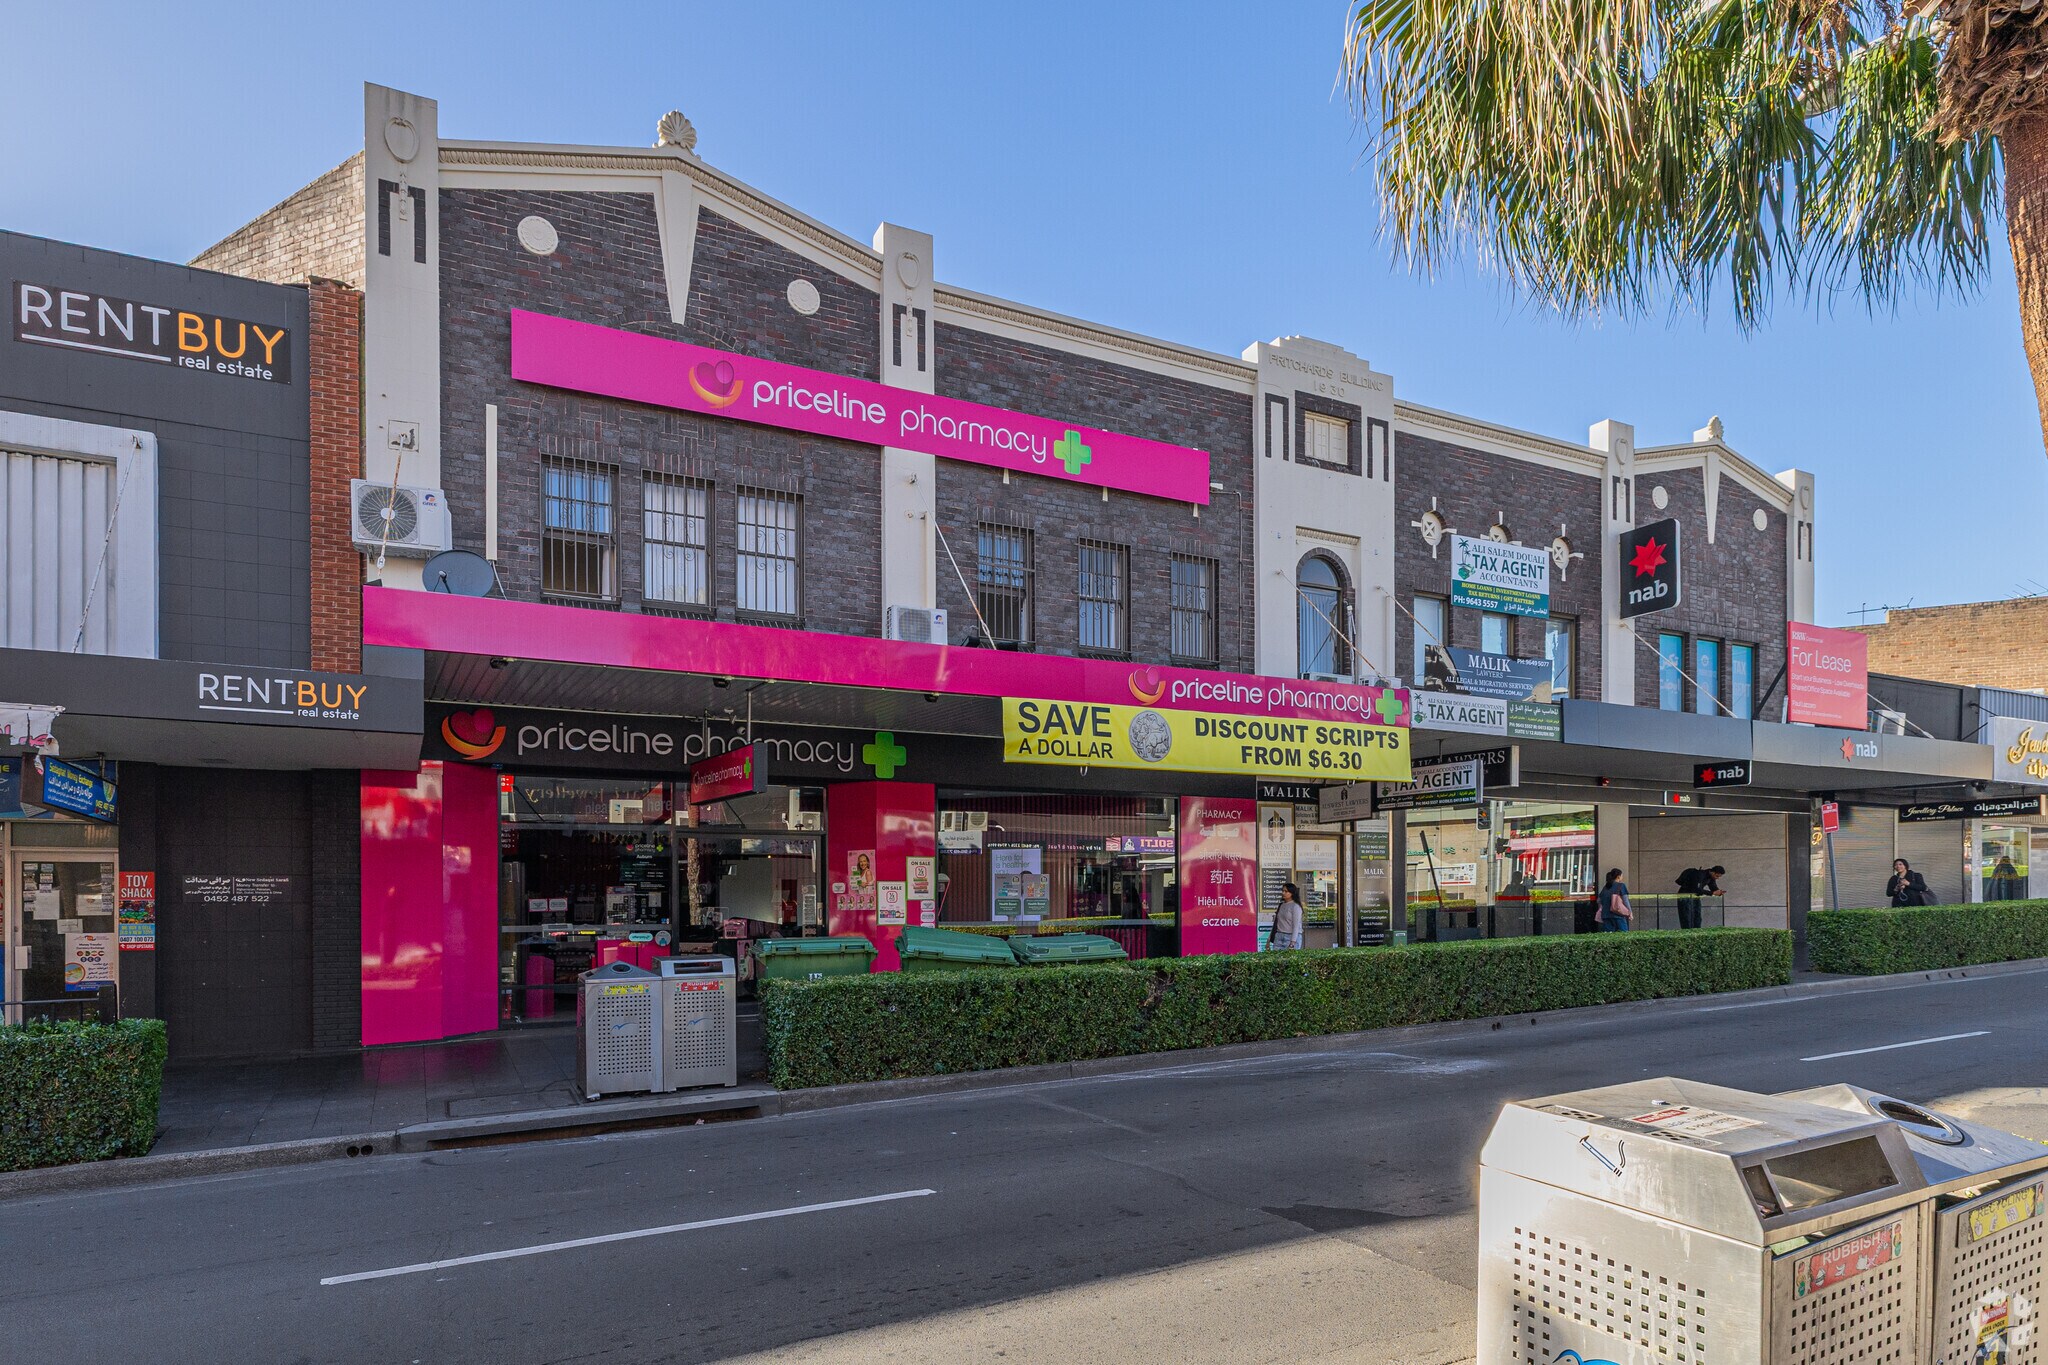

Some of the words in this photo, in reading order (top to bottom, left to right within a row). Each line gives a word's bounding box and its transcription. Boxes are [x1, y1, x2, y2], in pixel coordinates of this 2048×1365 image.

[22, 284, 284, 365] RENTBUY
[179, 355, 210, 371] real
[217, 360, 273, 381] estate
[1339, 371, 1384, 391] BUILDING
[753, 380, 886, 424] priceline
[900, 405, 1047, 464] pharmacy
[1471, 544, 1487, 554] ALI
[1487, 546, 1514, 559] SALEM
[1516, 551, 1545, 564] DOUALI
[1472, 554, 1498, 572] TAX
[1501, 559, 1545, 579] AGENT
[1480, 572, 1539, 588] ACCOUNTANTS
[1462, 582, 1476, 590] HOME
[1496, 588, 1525, 597] INVESTMENT
[1478, 592, 1500, 600] RETURNS
[1628, 579, 1668, 605] nab
[1453, 594, 1465, 604] PH:
[1465, 597, 1482, 607] 9643
[1482, 599, 1498, 608] 5557
[1468, 654, 1511, 672] MALIK
[1791, 646, 1813, 667] For
[1815, 649, 1852, 673] Lease
[1476, 669, 1503, 679] LAWYERS
[199, 673, 367, 710] RENTBUY
[1456, 685, 1523, 696] WWW.MALIKLAWYERS.COM.AU
[1457, 677, 1474, 685] LEGAL
[1479, 679, 1508, 688] MIGRATION
[1508, 682, 1533, 690] SERVICES
[1171, 679, 1263, 706] priceline
[1267, 683, 1372, 720] pharmacy
[1471, 702, 1505, 710] ACCOUNTANTS
[297, 706, 319, 718] real
[322, 707, 359, 721] estate
[1018, 702, 1112, 738] SAVE
[1428, 704, 1455, 720] TAX
[1458, 707, 1505, 725] AGENT
[517, 724, 673, 755] priceline
[1195, 717, 1309, 744] DISCOUNT
[1314, 727, 1400, 750] SCRIPTS
[1018, 738, 1033, 754] A
[1037, 739, 1114, 760] DOLLAR
[1241, 745, 1302, 767] FROM
[1307, 748, 1363, 770] $6.30
[1855, 740, 1878, 758] nab
[698, 771, 719, 786] priceline
[719, 764, 743, 782] pharmacy
[1422, 769, 1473, 788] AGENT
[1717, 765, 1745, 779] nab
[1263, 786, 1312, 798] MALIK
[1679, 794, 1691, 803] nab
[1344, 798, 1369, 807] LAWYERS
[1901, 806, 1937, 818] Jewellery
[1938, 804, 1964, 814] Palace
[1974, 800, 2020, 812] المجوهرات
[2021, 799, 2039, 810] قصر
[1197, 809, 1243, 820] PHARMACY
[125, 875, 149, 887] TOY
[1210, 869, 1234, 884] 药店
[121, 887, 153, 898] SHACK
[1197, 896, 1217, 908] Hiệu
[1218, 895, 1243, 906] Thuốc
[1202, 918, 1240, 927] eczane
[1977, 1187, 2029, 1218] RECYCLING
[1822, 1233, 1881, 1266] RUBBISH
[1982, 1305, 2007, 1324] WARNING
[1981, 1325, 1992, 1333] AREA
[1992, 1319, 2005, 1329] UNDER
